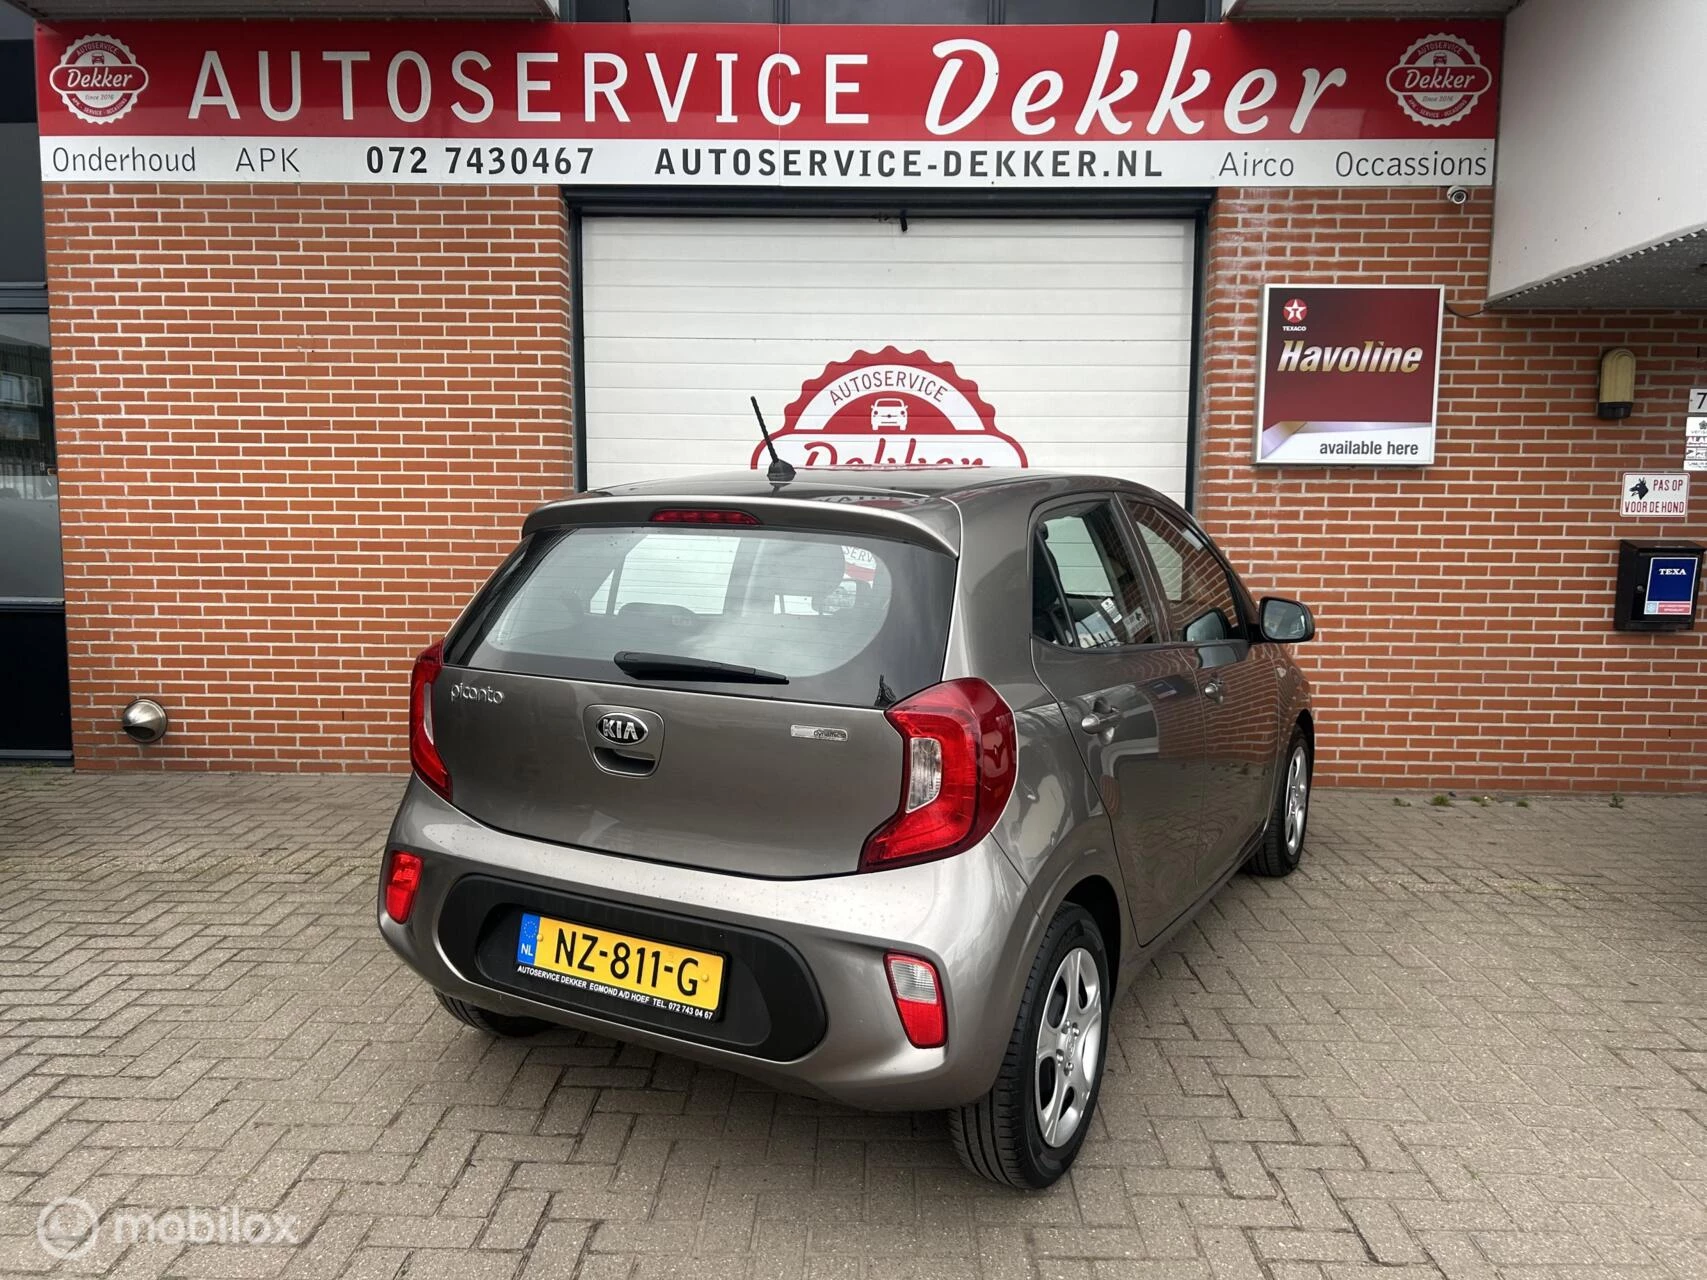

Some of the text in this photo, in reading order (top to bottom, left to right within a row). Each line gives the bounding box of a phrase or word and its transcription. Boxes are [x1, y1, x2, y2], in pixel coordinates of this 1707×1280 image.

[76, 42, 118, 56] AUTOSERVICE
[1417, 42, 1462, 56] AUTOSERVICE
[67, 67, 133, 88] Dekker
[188, 28, 1346, 136] AUTOSERVICE Dekker
[1404, 67, 1476, 89] Dekker
[52, 146, 299, 173] Onderhoud APK
[366, 146, 594, 175] 072 7430467
[655, 148, 1162, 177] AUTOSERVICE-DEKKER.NL
[1219, 151, 1487, 177] Airco Occassions
[1277, 339, 1423, 373] Havoline
[829, 370, 949, 406] AUTOSERVICE
[1319, 441, 1418, 455] available here
[1653, 479, 1684, 491] PAS OP
[1625, 501, 1685, 513] VOOR DE HOND
[1658, 568, 1687, 576] TEXA
[451, 682, 505, 704] picanto
[602, 718, 638, 741] KIA
[520, 943, 534, 957] NL
[554, 927, 699, 996] NZ-811-G
[517, 965, 713, 1020] AUTOSERVICE DEKKER EGMOND A/D HOEF TEL. 072 743 04 67
